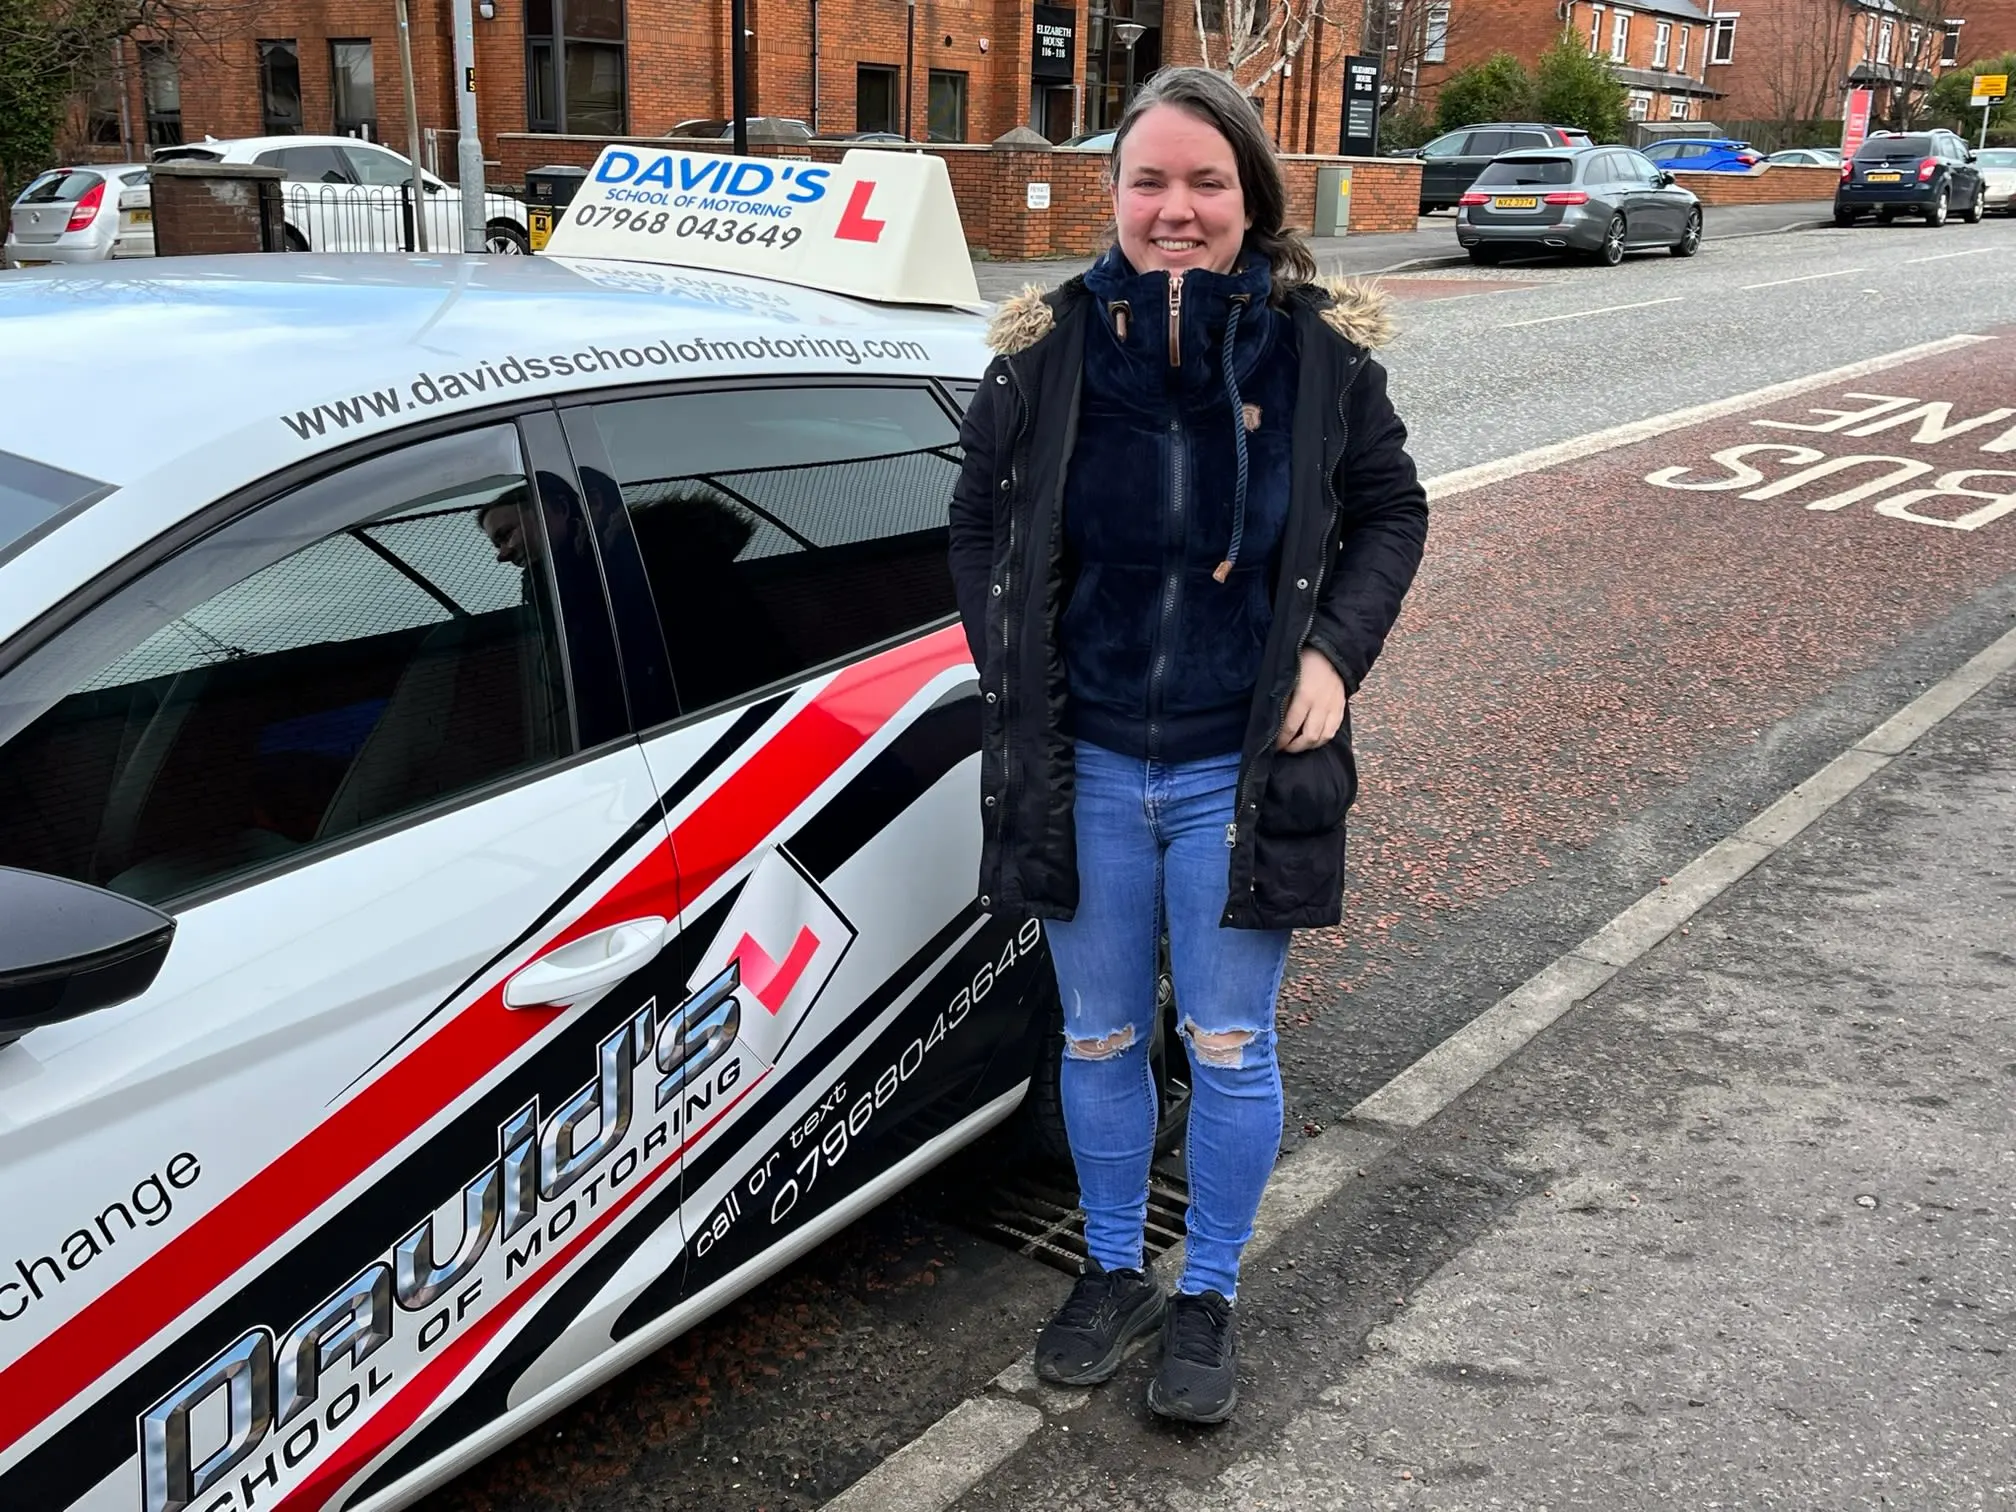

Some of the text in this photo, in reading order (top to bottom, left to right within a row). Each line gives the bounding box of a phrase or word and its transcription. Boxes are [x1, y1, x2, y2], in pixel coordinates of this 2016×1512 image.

[1036, 24, 1072, 37] ELIZABETH
[1042, 36, 1065, 47] HOUSE
[595, 151, 830, 203] DAVID'S
[605, 188, 792, 219] SCHOOL OF MOTORING
[575, 204, 802, 250] 07968 043649
[834, 180, 886, 243] L
[280, 334, 930, 441] www.davidsschoolofmotoring.com
[1644, 443, 2016, 531] BUS
[770, 916, 1041, 1225] 07968043649
[696, 1081, 847, 1257] call or text
[417, 1279, 483, 1355] OF
[505, 1058, 741, 1281] MOTORING
